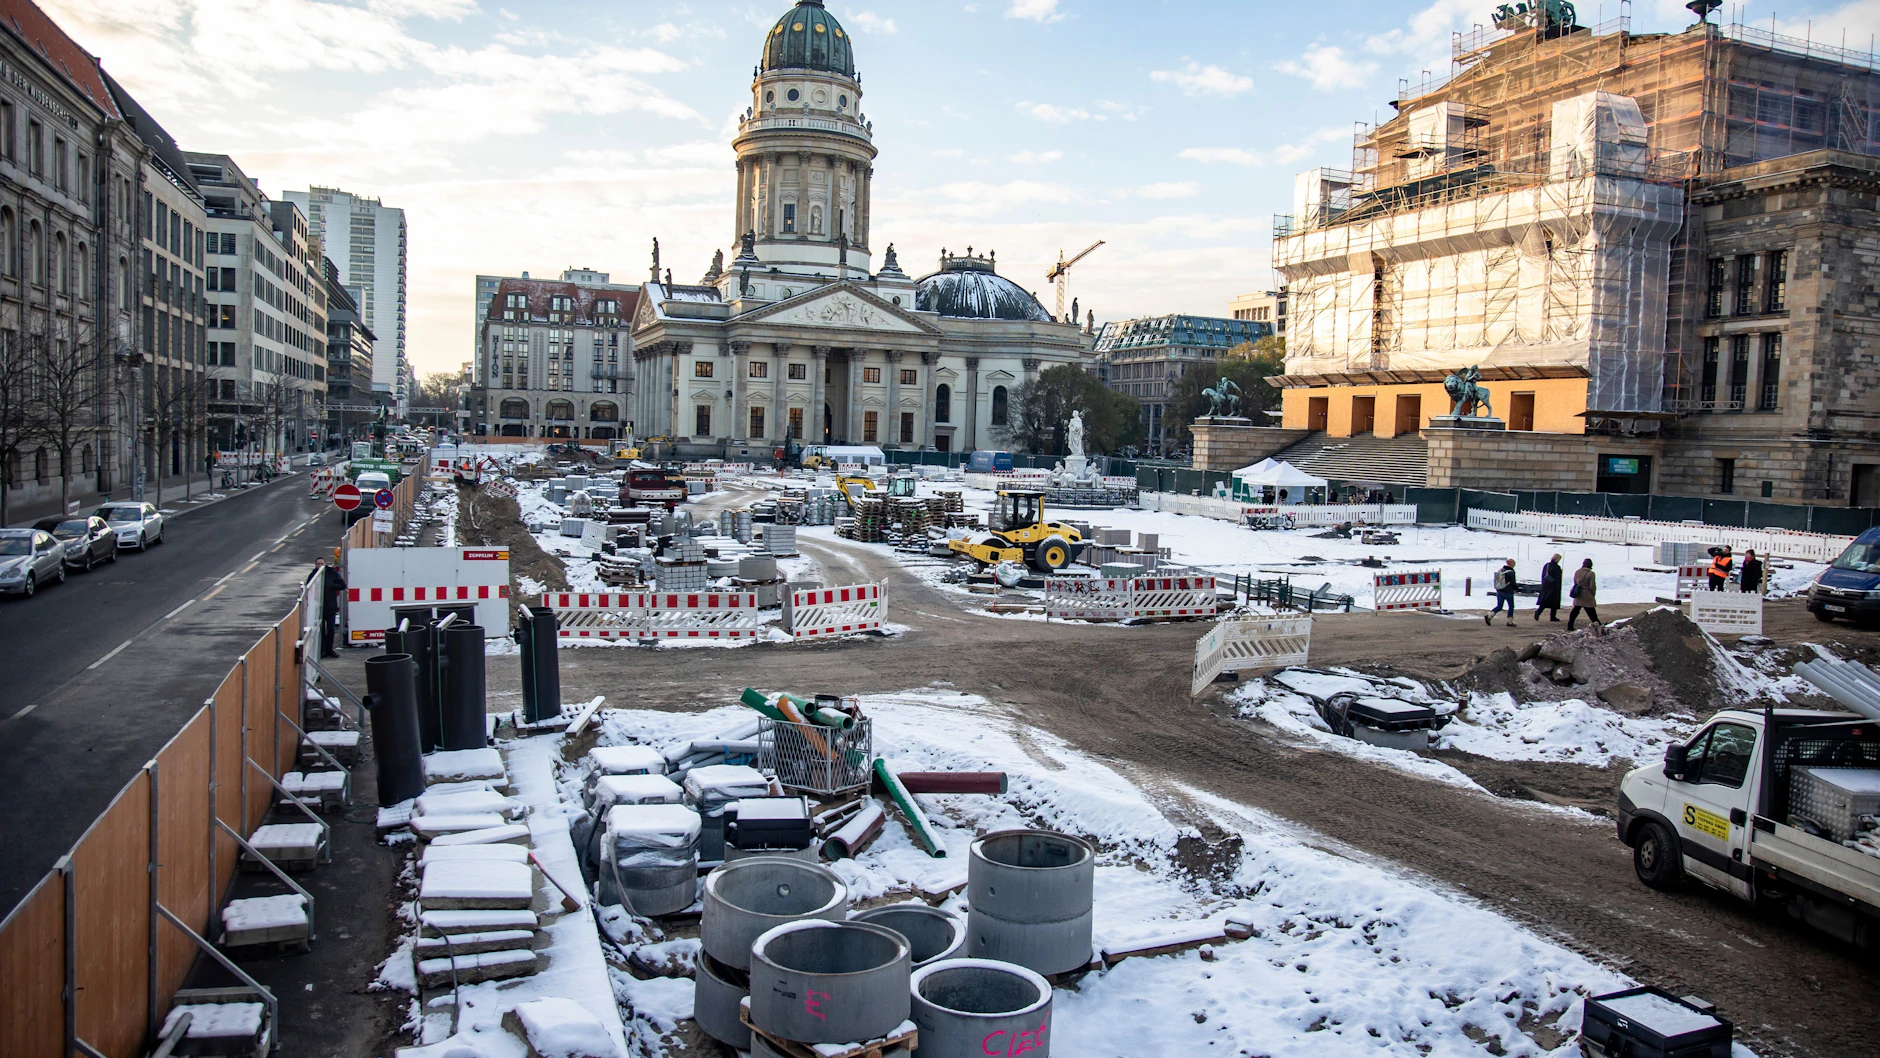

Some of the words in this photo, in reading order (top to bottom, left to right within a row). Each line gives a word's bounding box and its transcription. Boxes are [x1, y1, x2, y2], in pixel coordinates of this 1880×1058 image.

[13, 71, 27, 91] DER
[492, 335, 500, 378] HILTON
[1684, 805, 1696, 825] S
[805, 988, 831, 1020] E
